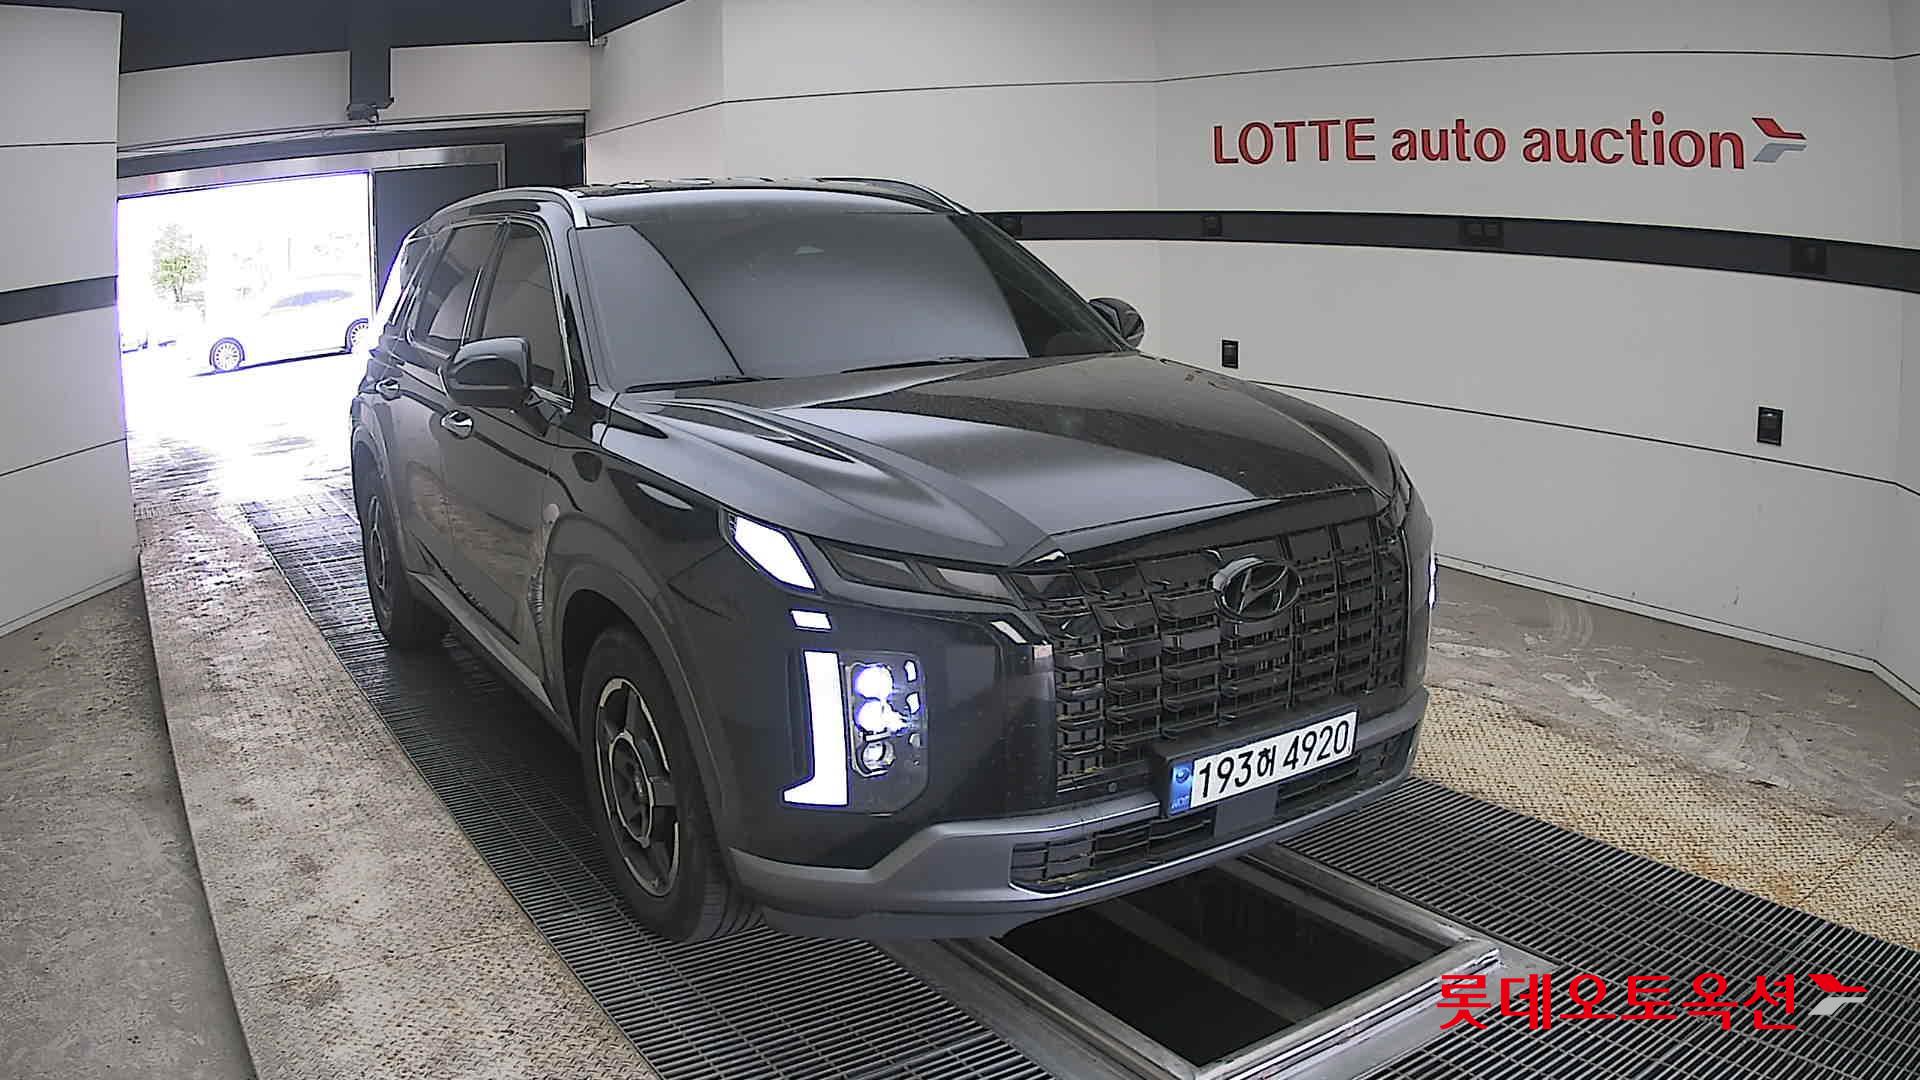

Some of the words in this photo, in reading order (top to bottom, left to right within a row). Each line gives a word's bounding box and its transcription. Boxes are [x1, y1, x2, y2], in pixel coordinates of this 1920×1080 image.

[1214, 117, 1376, 165] LOTTE
[1391, 118, 1507, 162] auto
[1522, 111, 1745, 170] auction
[1199, 744, 1277, 799] 193허
[1283, 720, 1350, 771] 4920
